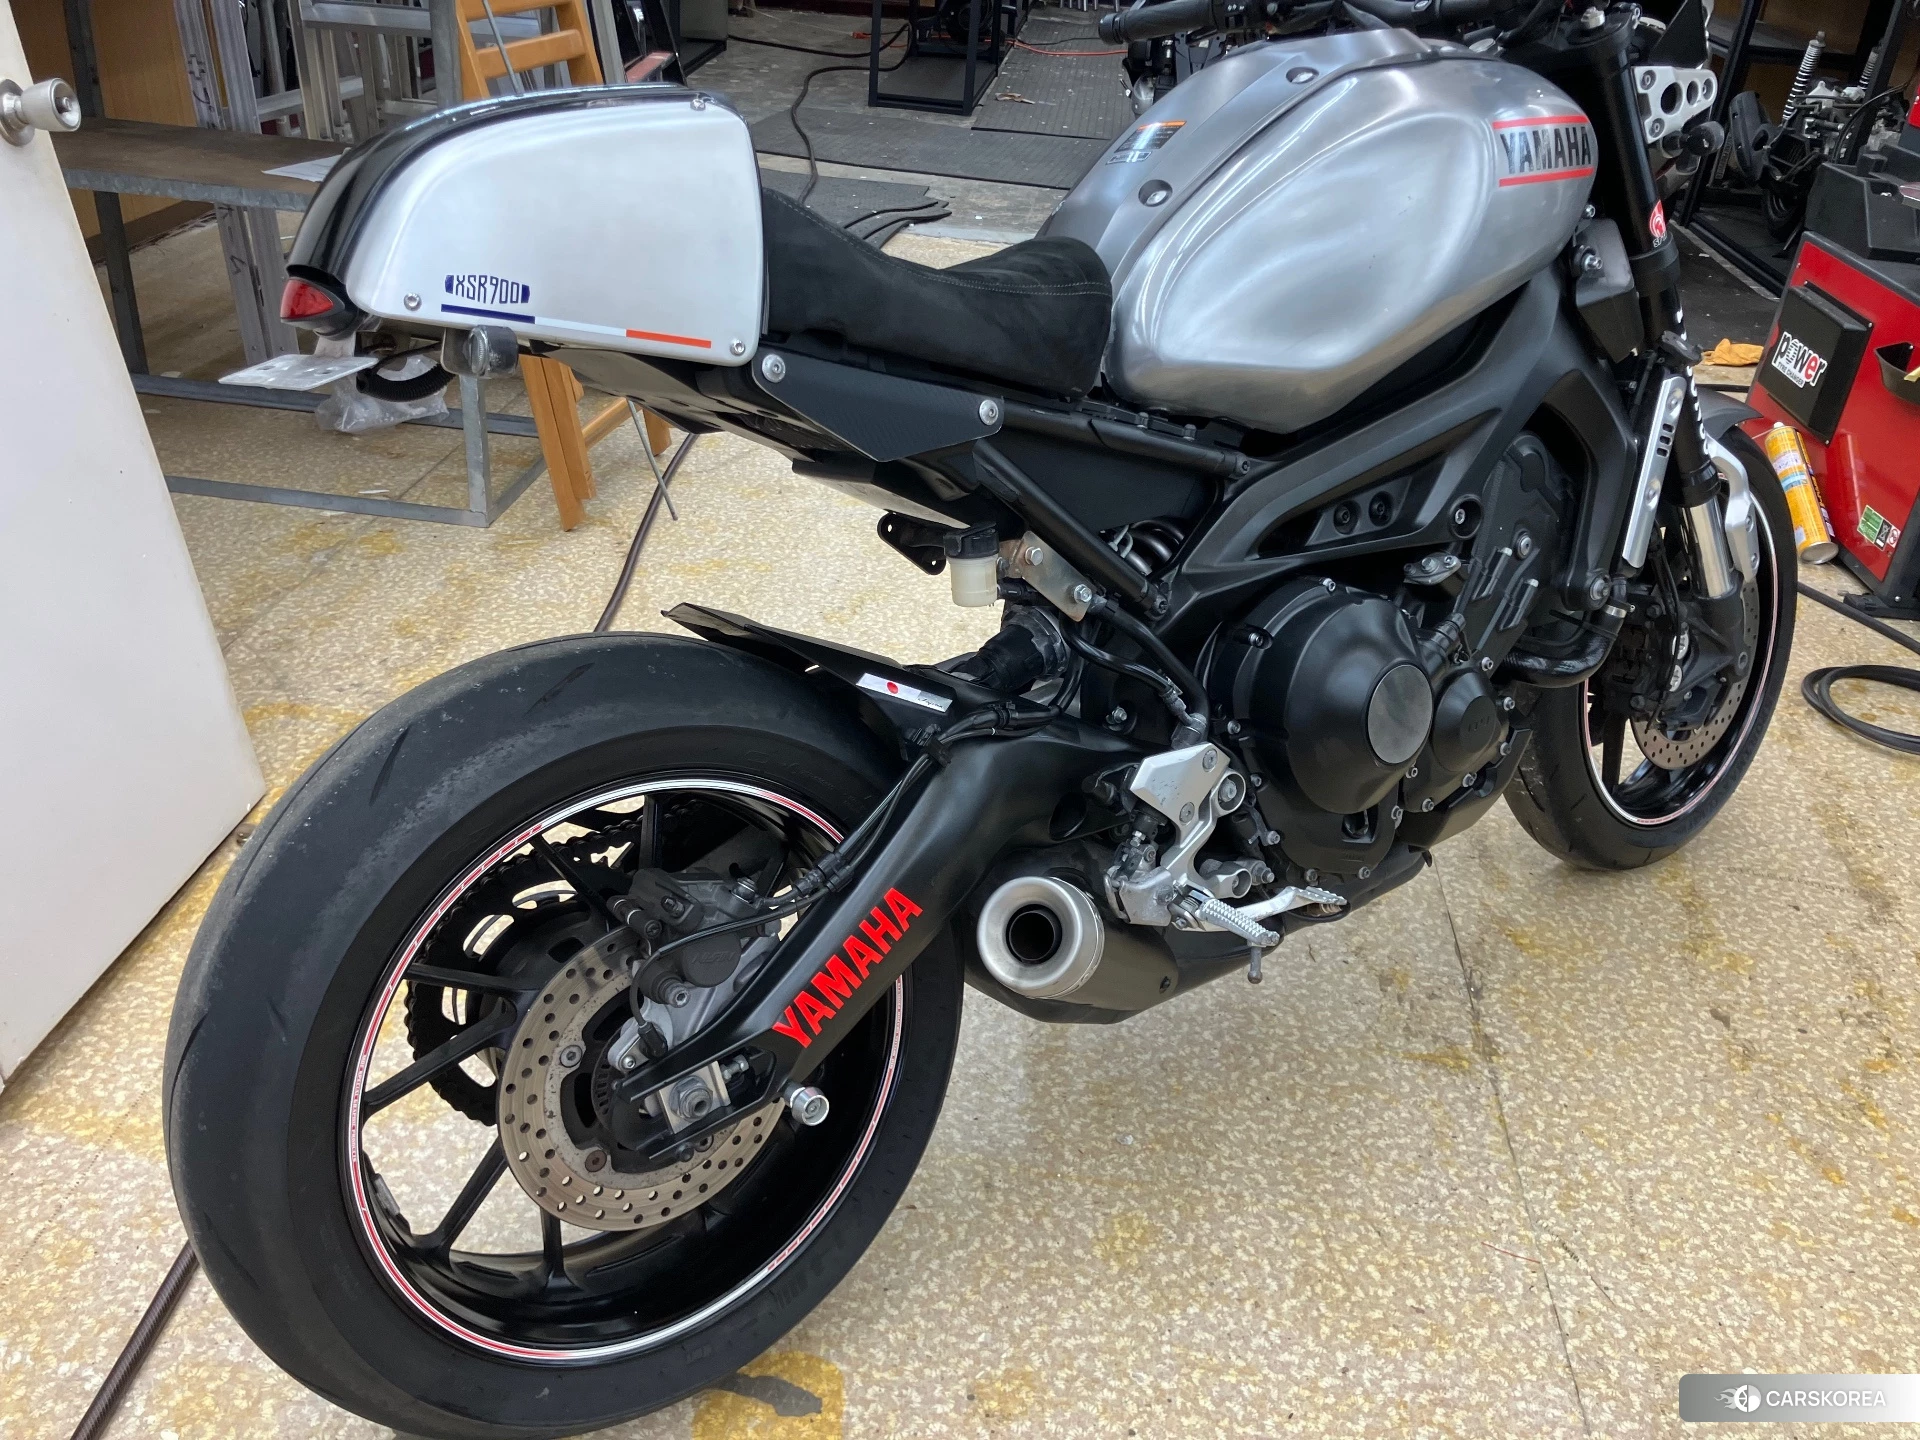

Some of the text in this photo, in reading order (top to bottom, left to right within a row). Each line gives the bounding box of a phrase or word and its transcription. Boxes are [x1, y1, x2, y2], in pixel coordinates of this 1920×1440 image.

[1500, 126, 1592, 175] YAMAHA
[455, 274, 520, 304] XSR900
[771, 887, 924, 1049] YAMAHA
